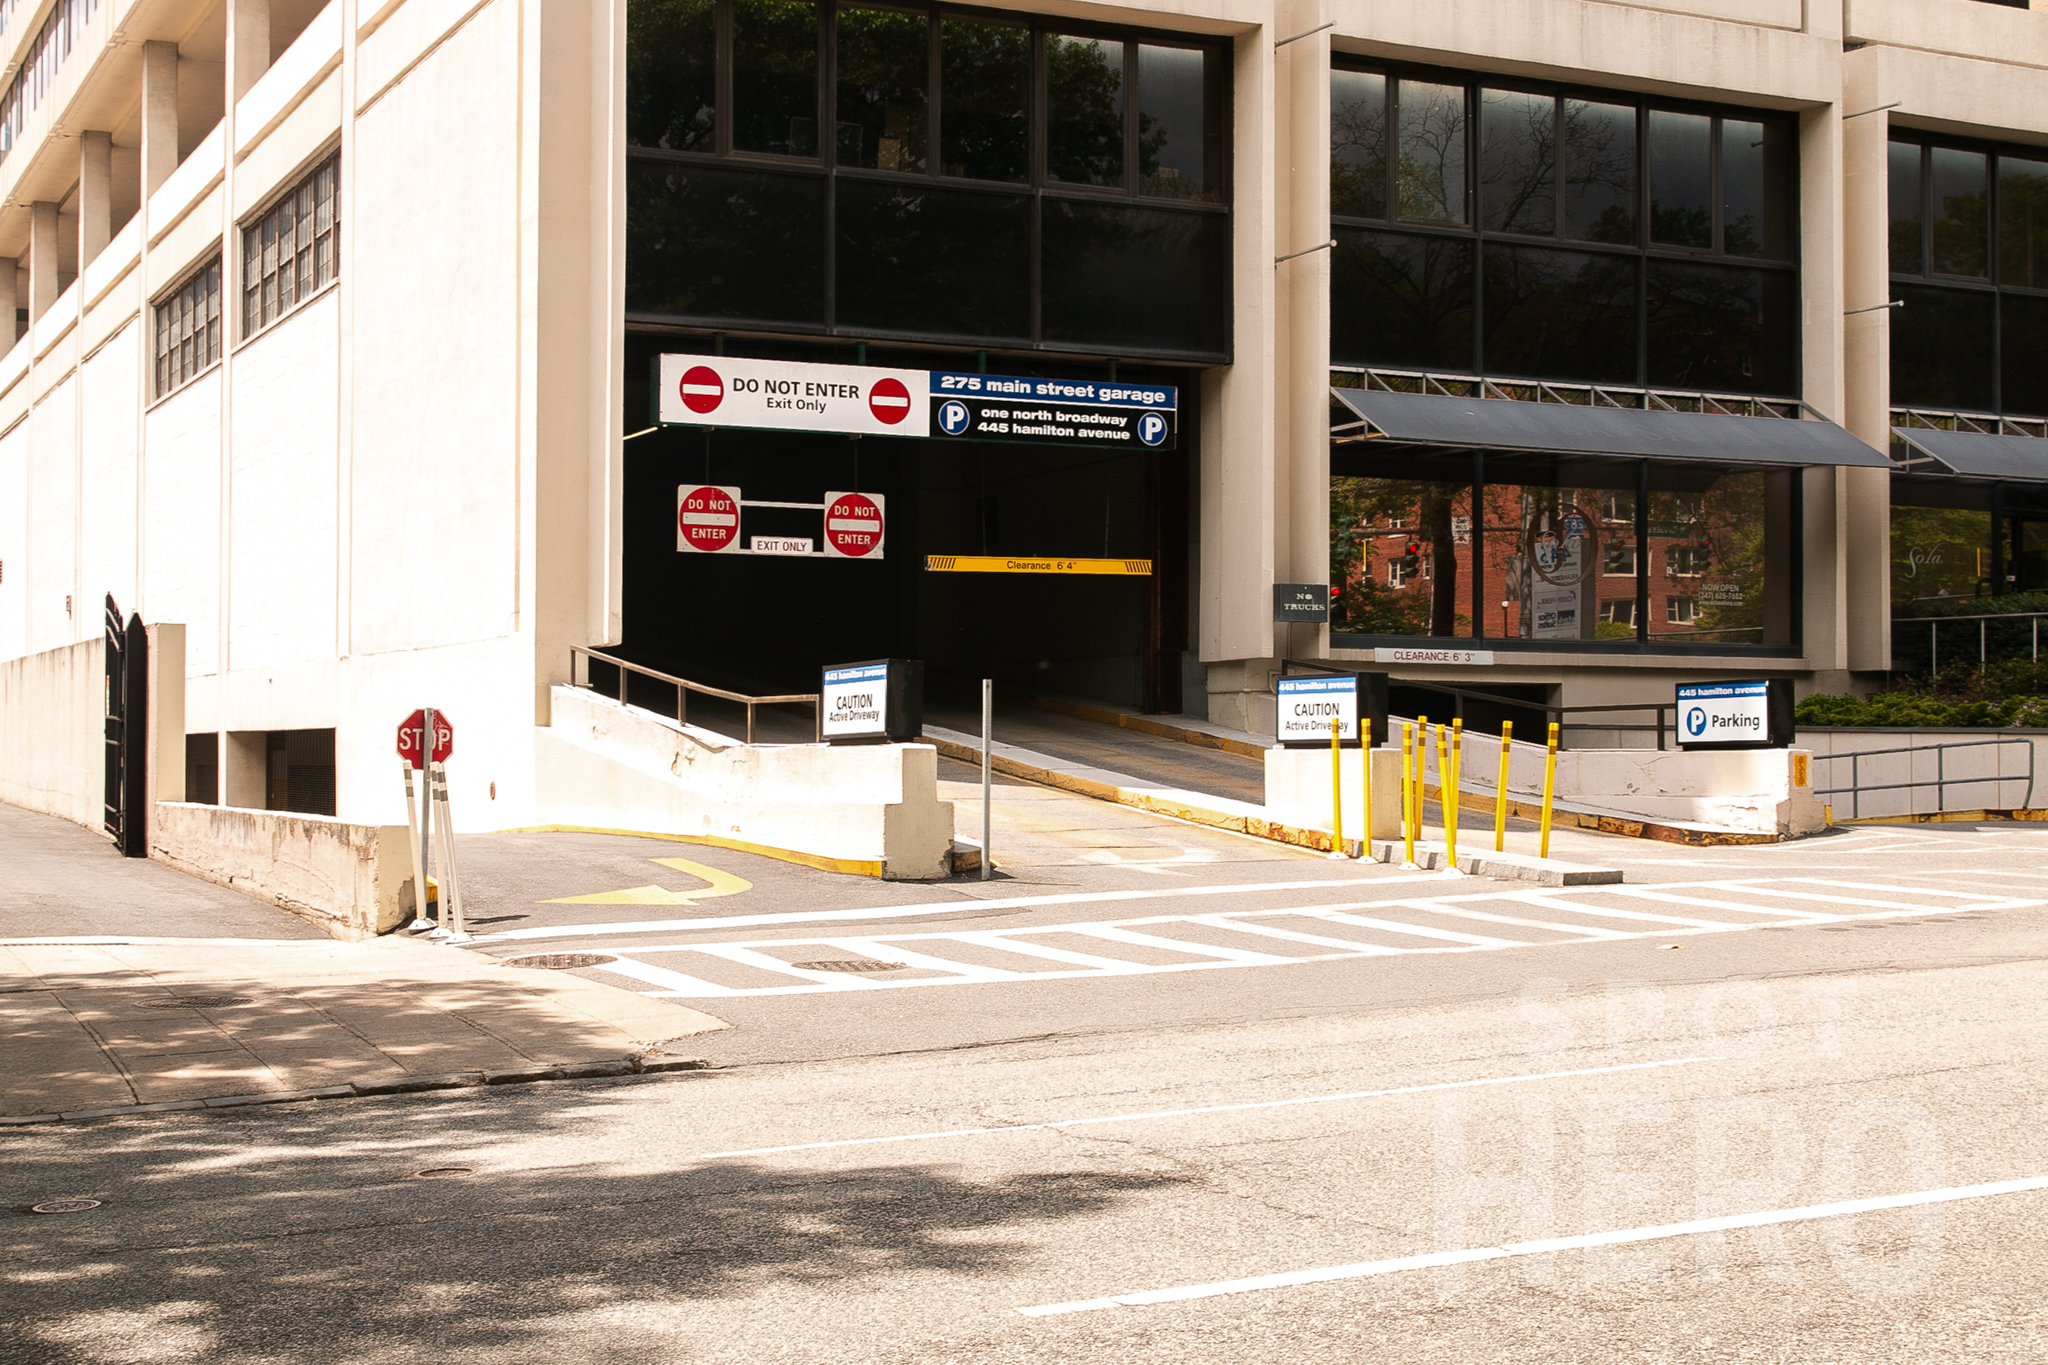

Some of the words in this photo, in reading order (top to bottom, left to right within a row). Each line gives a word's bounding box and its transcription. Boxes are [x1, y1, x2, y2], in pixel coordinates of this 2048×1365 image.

[733, 378, 759, 393] DO
[764, 381, 800, 395] NOT
[806, 383, 859, 398] ENTER
[941, 376, 981, 389] 275
[986, 380, 1030, 393] main
[1037, 382, 1094, 398] street
[1099, 388, 1166, 404] garage
[767, 397, 792, 409] Exit
[796, 399, 826, 413] Only
[946, 405, 965, 429] P
[981, 409, 1008, 418] one
[1013, 410, 1051, 421] north
[1056, 411, 1127, 427] broadway
[978, 422, 1009, 432] 445
[1012, 423, 1074, 437] hamilton
[1078, 428, 1130, 440] avenue
[1145, 417, 1163, 440] P
[688, 499, 704, 509] DO
[709, 500, 731, 511] NOT
[834, 505, 850, 515] DO
[854, 507, 875, 517] NOT
[692, 528, 726, 539] ENTER
[838, 534, 871, 545] ENTER
[757, 541, 779, 551] EXIT
[783, 542, 807, 552] ONLY
[1006, 560, 1051, 570] Clearance
[1905, 542, 1949, 578] Sola
[1394, 651, 1449, 661] CLEARANCE
[1698, 687, 1733, 696] hamilton
[1735, 686, 1766, 694] avenue
[837, 694, 872, 710] CAUTION
[829, 711, 848, 722] Active
[850, 710, 880, 722] Driveway
[1294, 703, 1340, 716] CAUTION
[1285, 721, 1309, 730] Active
[1311, 720, 1348, 732] Driveay
[1690, 710, 1704, 733] P
[1712, 713, 1760, 730] Parking
[399, 728, 451, 751] STP
